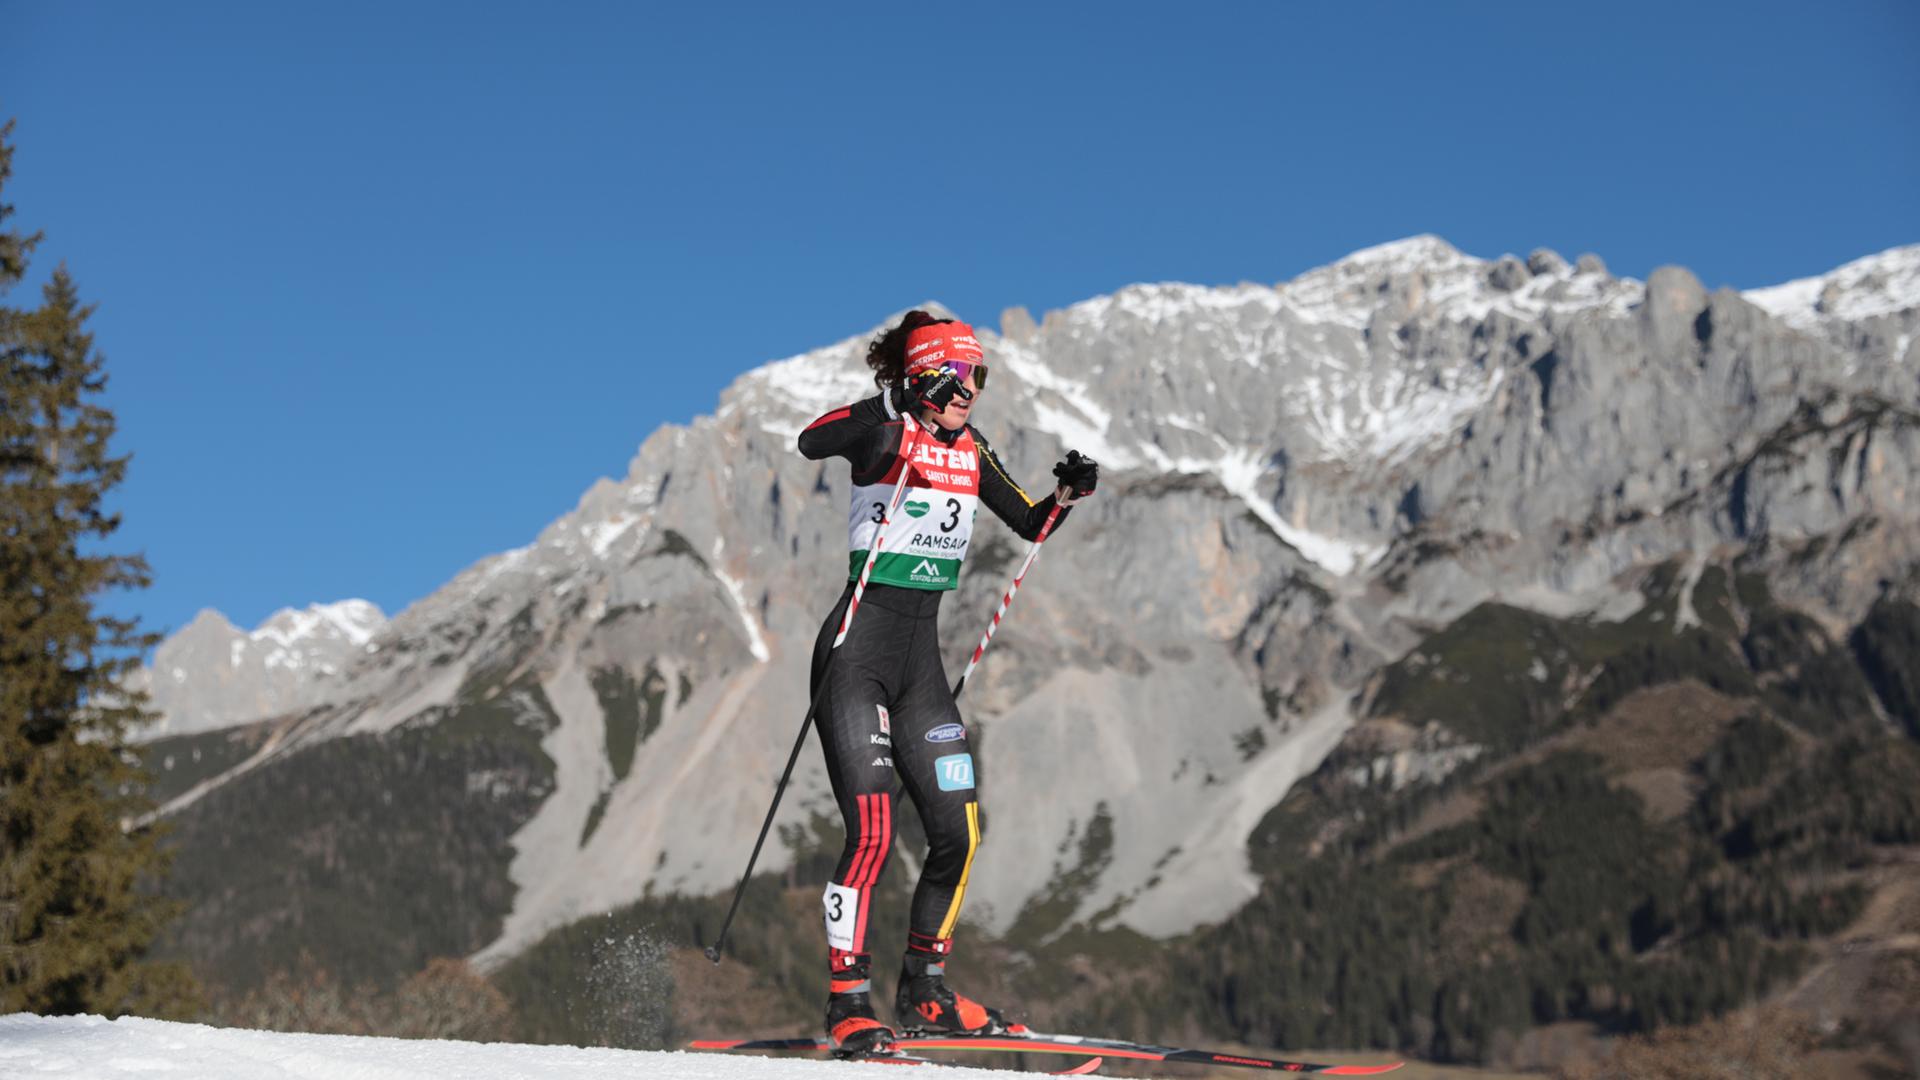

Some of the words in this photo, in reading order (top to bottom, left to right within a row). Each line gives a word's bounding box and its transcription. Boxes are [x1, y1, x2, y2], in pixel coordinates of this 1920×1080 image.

[871, 502, 886, 525] 3
[940, 498, 961, 533] 3
[942, 759, 970, 785] TQ
[828, 893, 843, 923] 3
